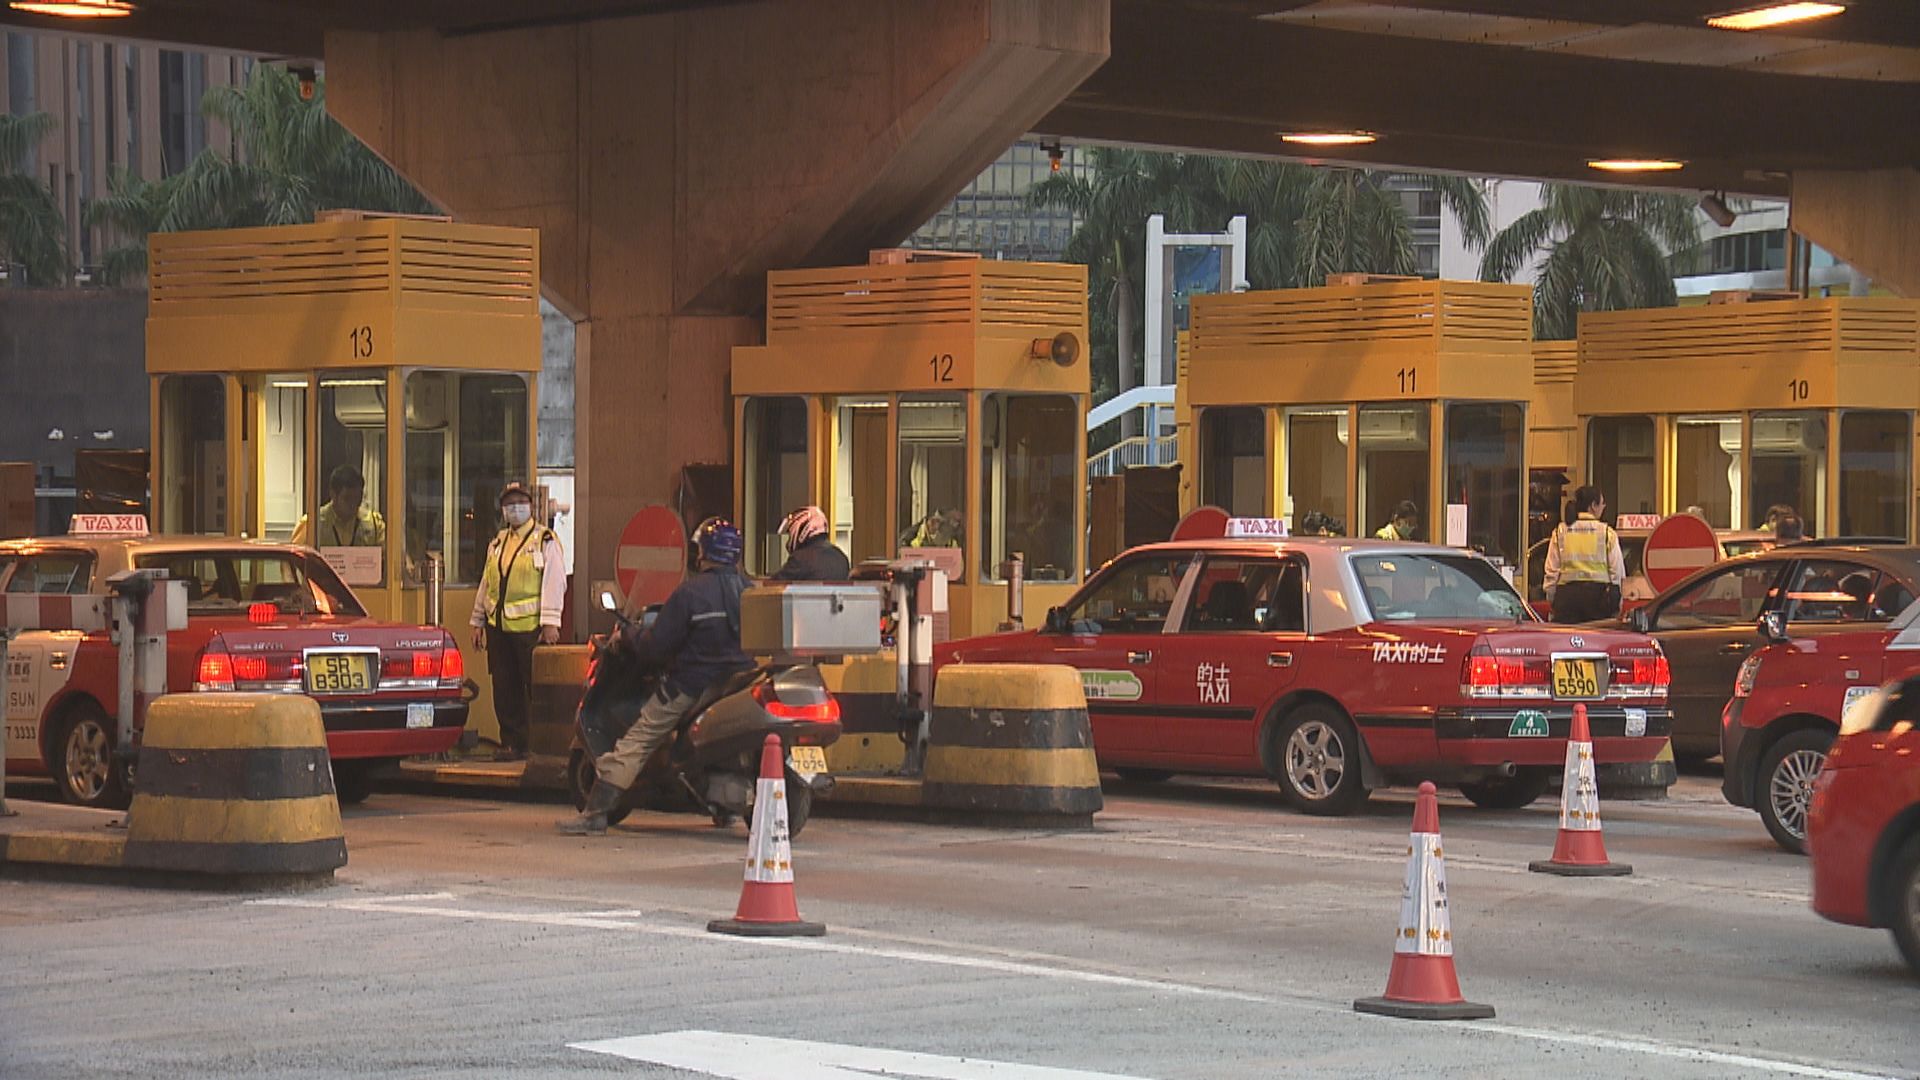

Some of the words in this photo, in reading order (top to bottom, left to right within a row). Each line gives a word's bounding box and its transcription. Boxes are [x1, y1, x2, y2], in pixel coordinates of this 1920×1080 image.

[350, 326, 373, 359] 13
[930, 354, 953, 383] 12
[1397, 367, 1415, 393] 11
[1788, 379, 1809, 402] 10
[81, 516, 143, 531] TAXI
[1239, 520, 1284, 534] TAXI
[326, 657, 350, 673] SR
[1196, 662, 1231, 682] 的士
[1565, 661, 1584, 679] VN
[315, 672, 364, 689] 8303
[1558, 677, 1595, 696] 5590
[10, 691, 35, 707] SUN
[1197, 681, 1230, 703] TAXI
[1526, 715, 1534, 728] 4
